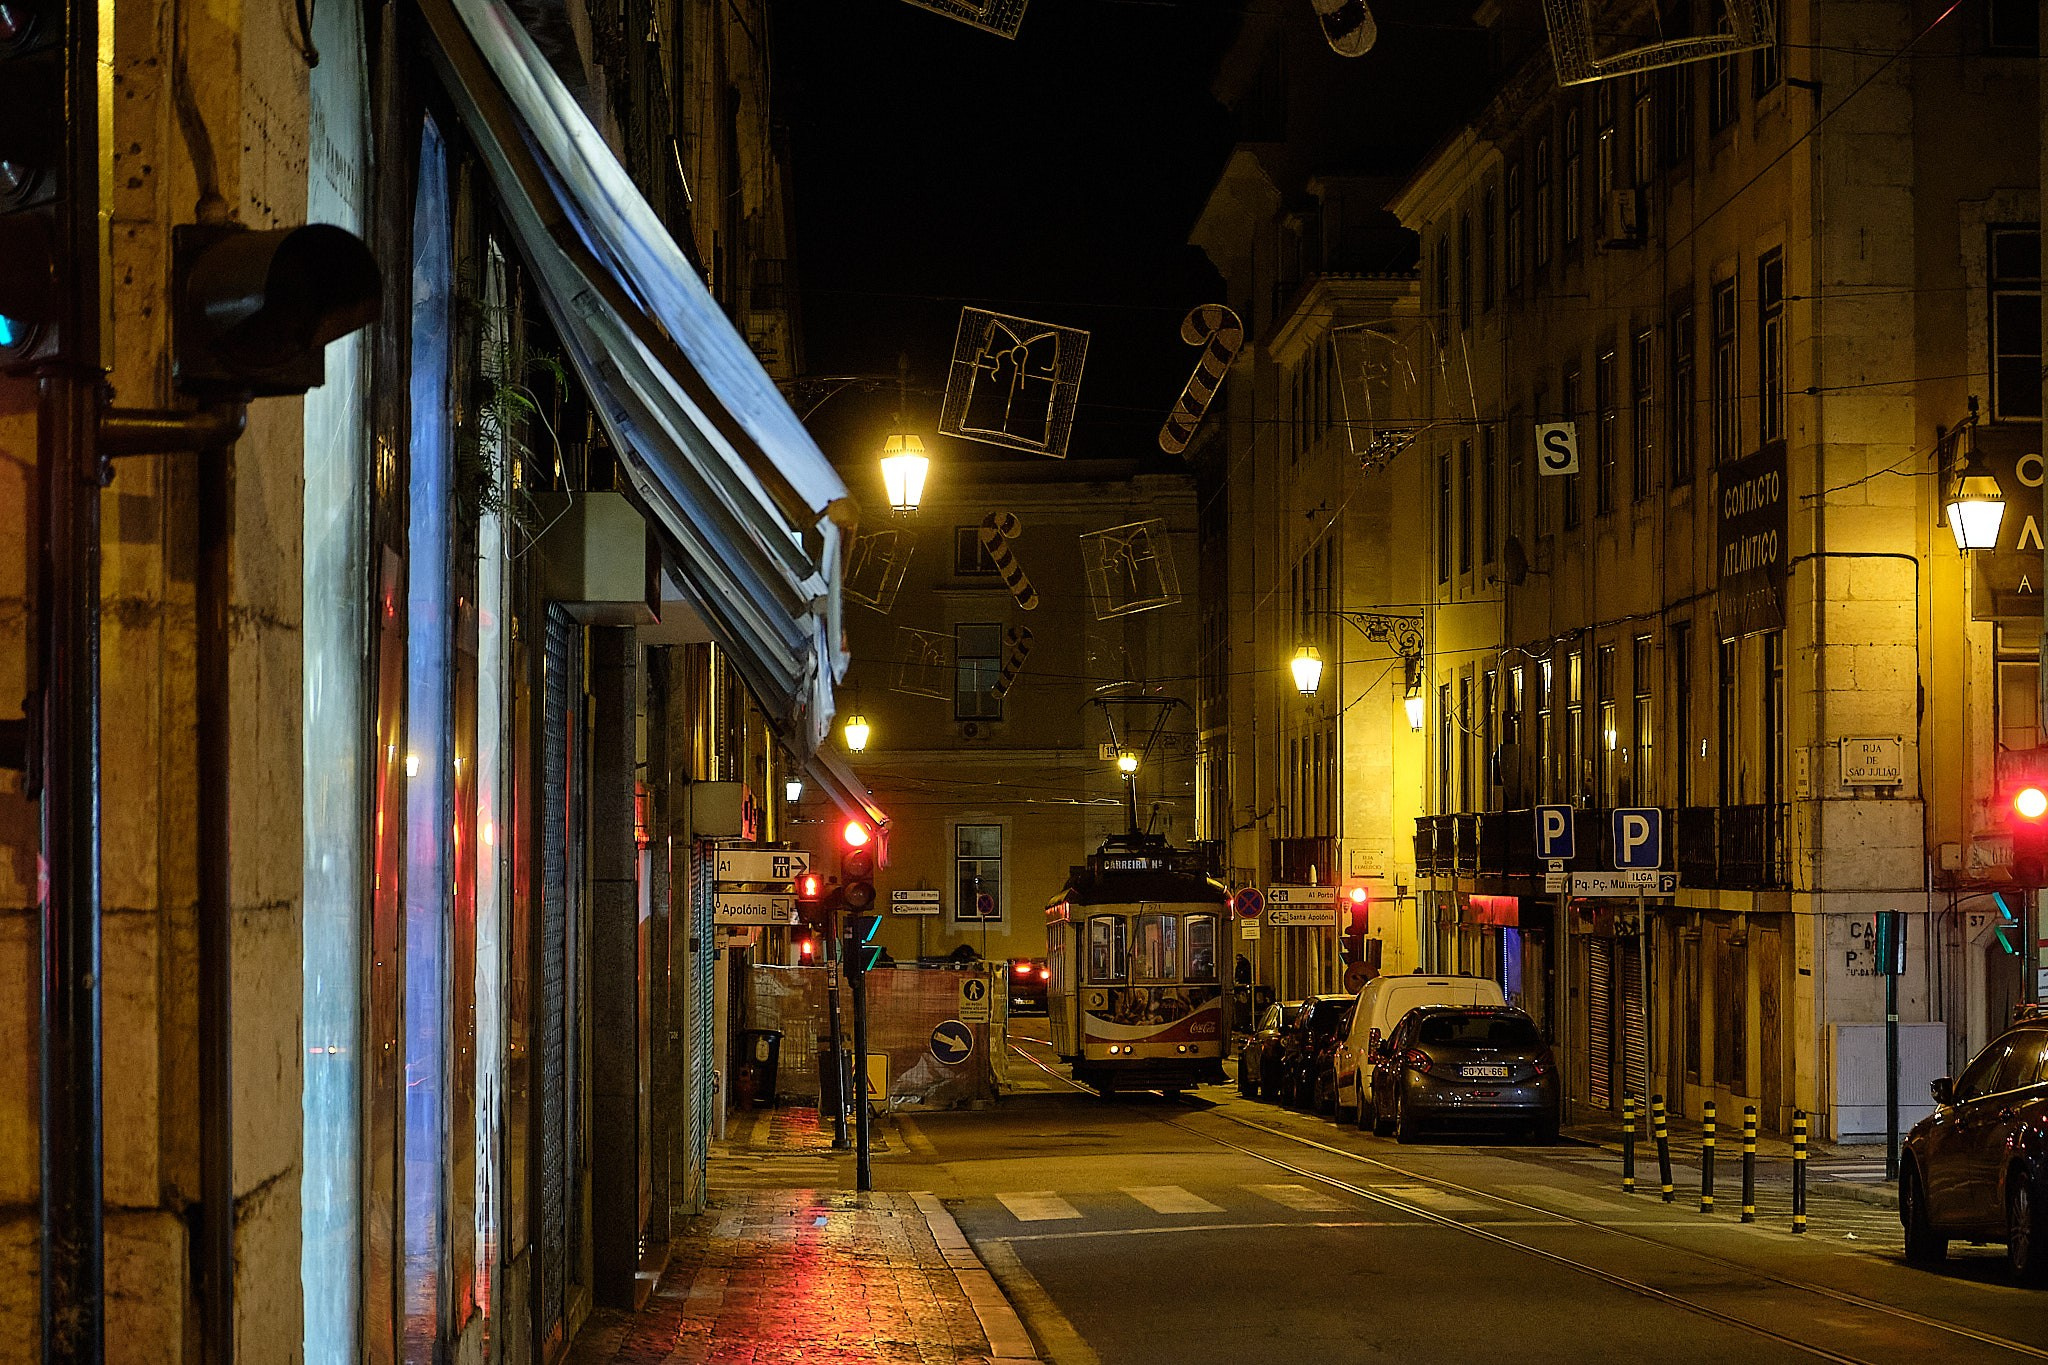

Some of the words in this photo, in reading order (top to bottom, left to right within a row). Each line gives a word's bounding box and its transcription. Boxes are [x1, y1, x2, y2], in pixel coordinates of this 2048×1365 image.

[1724, 470, 1779, 520] CONTACTO
[1862, 744, 1882, 753] RUA
[1866, 756, 1878, 765] DE
[1542, 810, 1566, 854] P
[1622, 815, 1650, 863] P
[719, 860, 731, 872] A1
[1104, 860, 1147, 870] CARREIRA
[1632, 872, 1653, 882] ILGA
[1575, 880, 1590, 891] Pq.
[1593, 880, 1608, 891] Pç.
[722, 903, 767, 917] Apolónia
[1289, 913, 1306, 921] Santa
[1970, 915, 1985, 927] 37
